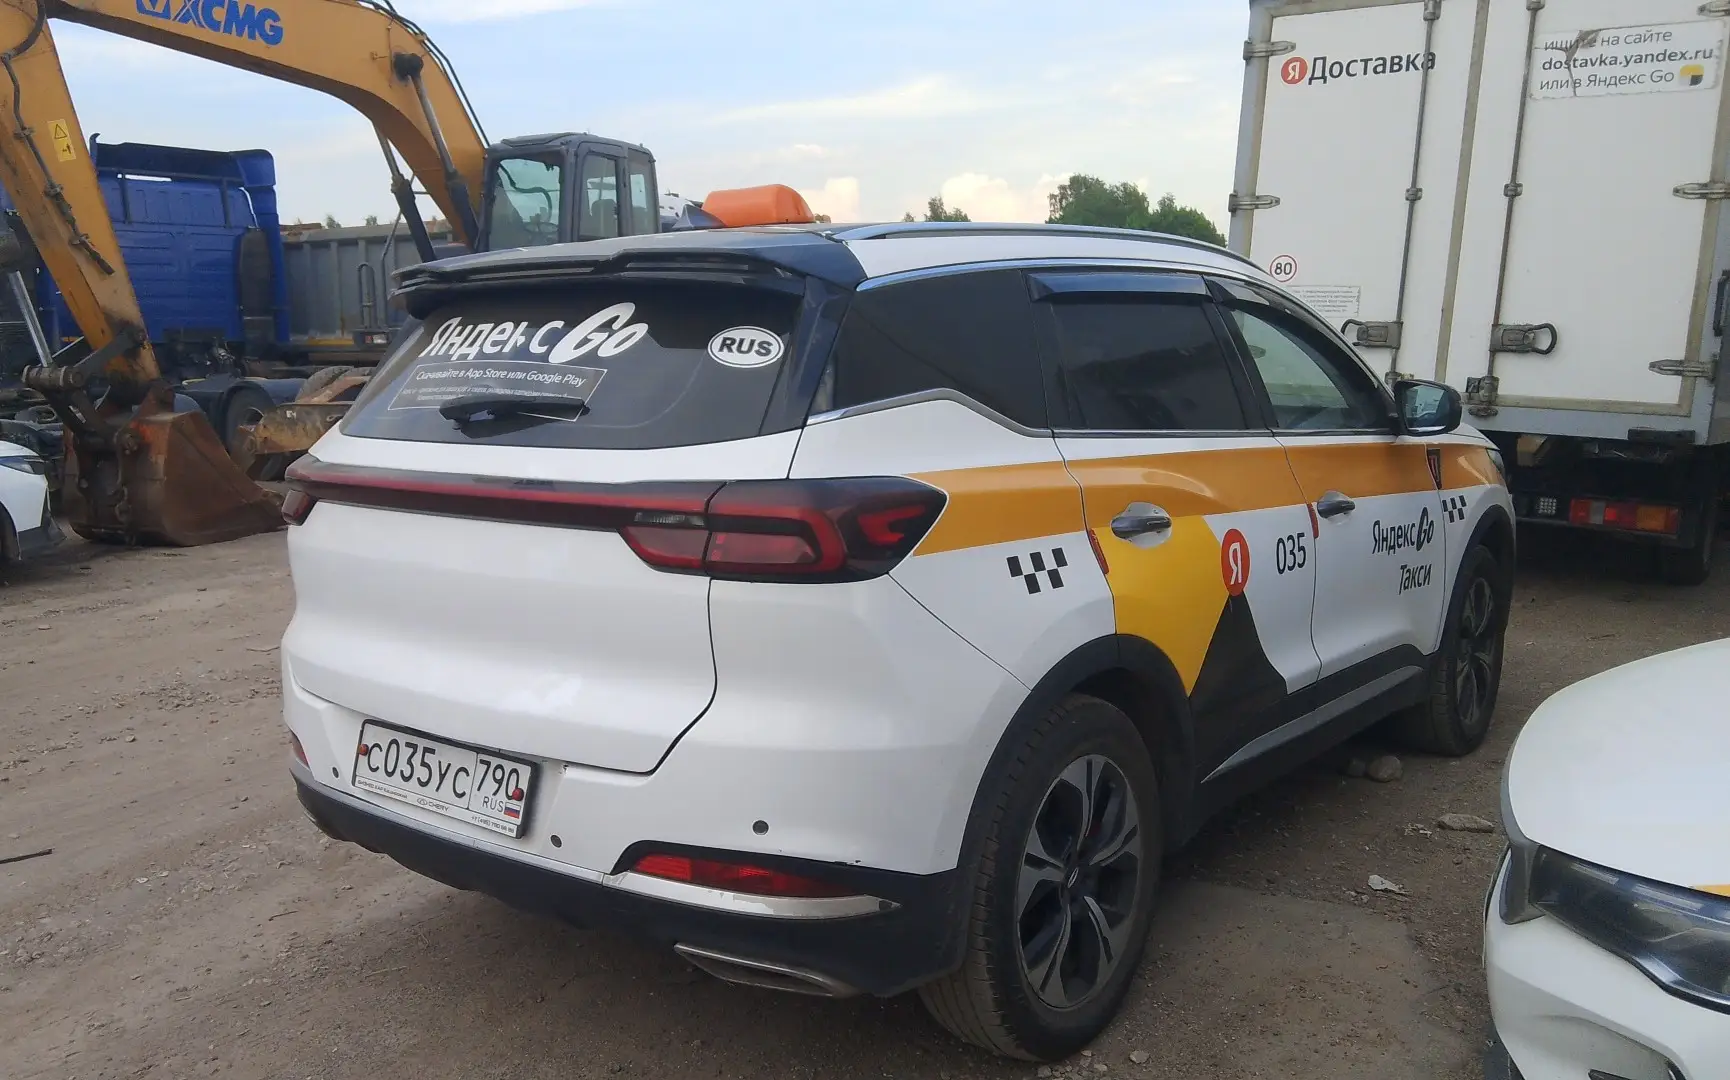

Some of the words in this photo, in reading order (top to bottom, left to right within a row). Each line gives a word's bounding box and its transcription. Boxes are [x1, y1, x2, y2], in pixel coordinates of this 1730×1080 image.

[172, 0, 283, 46] XCMG
[1600, 35, 1620, 46] на
[1624, 30, 1673, 45] сайте
[1308, 52, 1436, 85] Доставка
[1542, 48, 1713, 71] dostavka.yandex.ru
[1540, 79, 1569, 91] или
[1586, 73, 1647, 88] Яндекс
[1650, 70, 1675, 83] Go
[1275, 262, 1293, 275] 80
[548, 302, 649, 364] Go
[718, 336, 774, 357] RUS
[464, 368, 483, 379] App
[483, 368, 507, 379] Store
[506, 370, 526, 380] или
[526, 370, 562, 384] Google
[562, 374, 586, 388] Play
[1372, 519, 1416, 555] Яндекс
[1416, 506, 1435, 552] Go
[1229, 541, 1242, 585] Я
[1276, 532, 1307, 575] 035
[1399, 563, 1432, 596] Такси
[477, 758, 520, 801] 790
[482, 796, 503, 813] RUS
